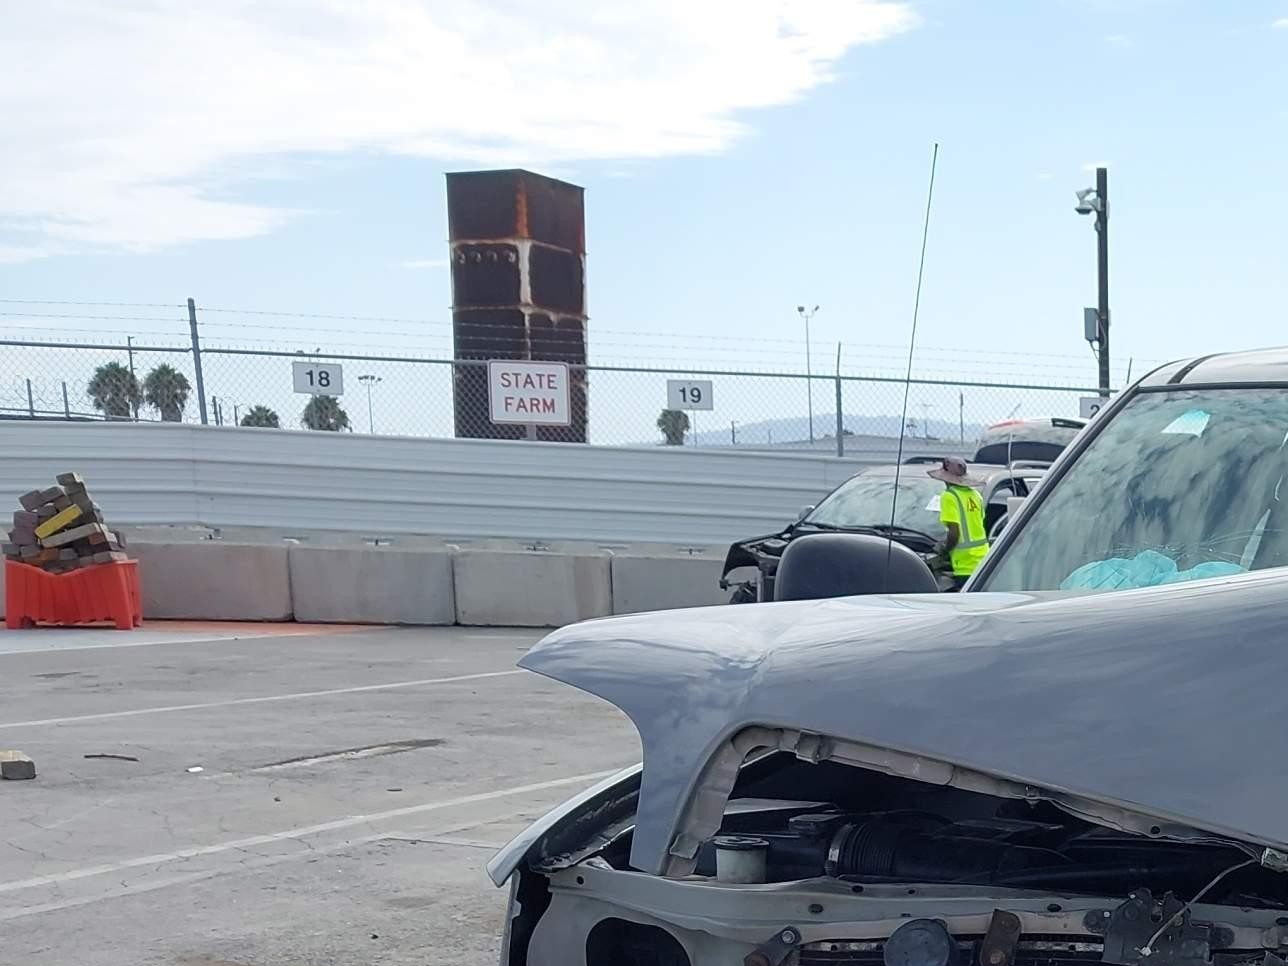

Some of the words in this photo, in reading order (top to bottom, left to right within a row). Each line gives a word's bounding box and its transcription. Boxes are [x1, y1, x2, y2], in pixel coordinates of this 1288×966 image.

[305, 370, 330, 387] 18
[500, 372, 557, 390] STATE
[679, 387, 701, 403] 19
[505, 396, 555, 413] FARM
